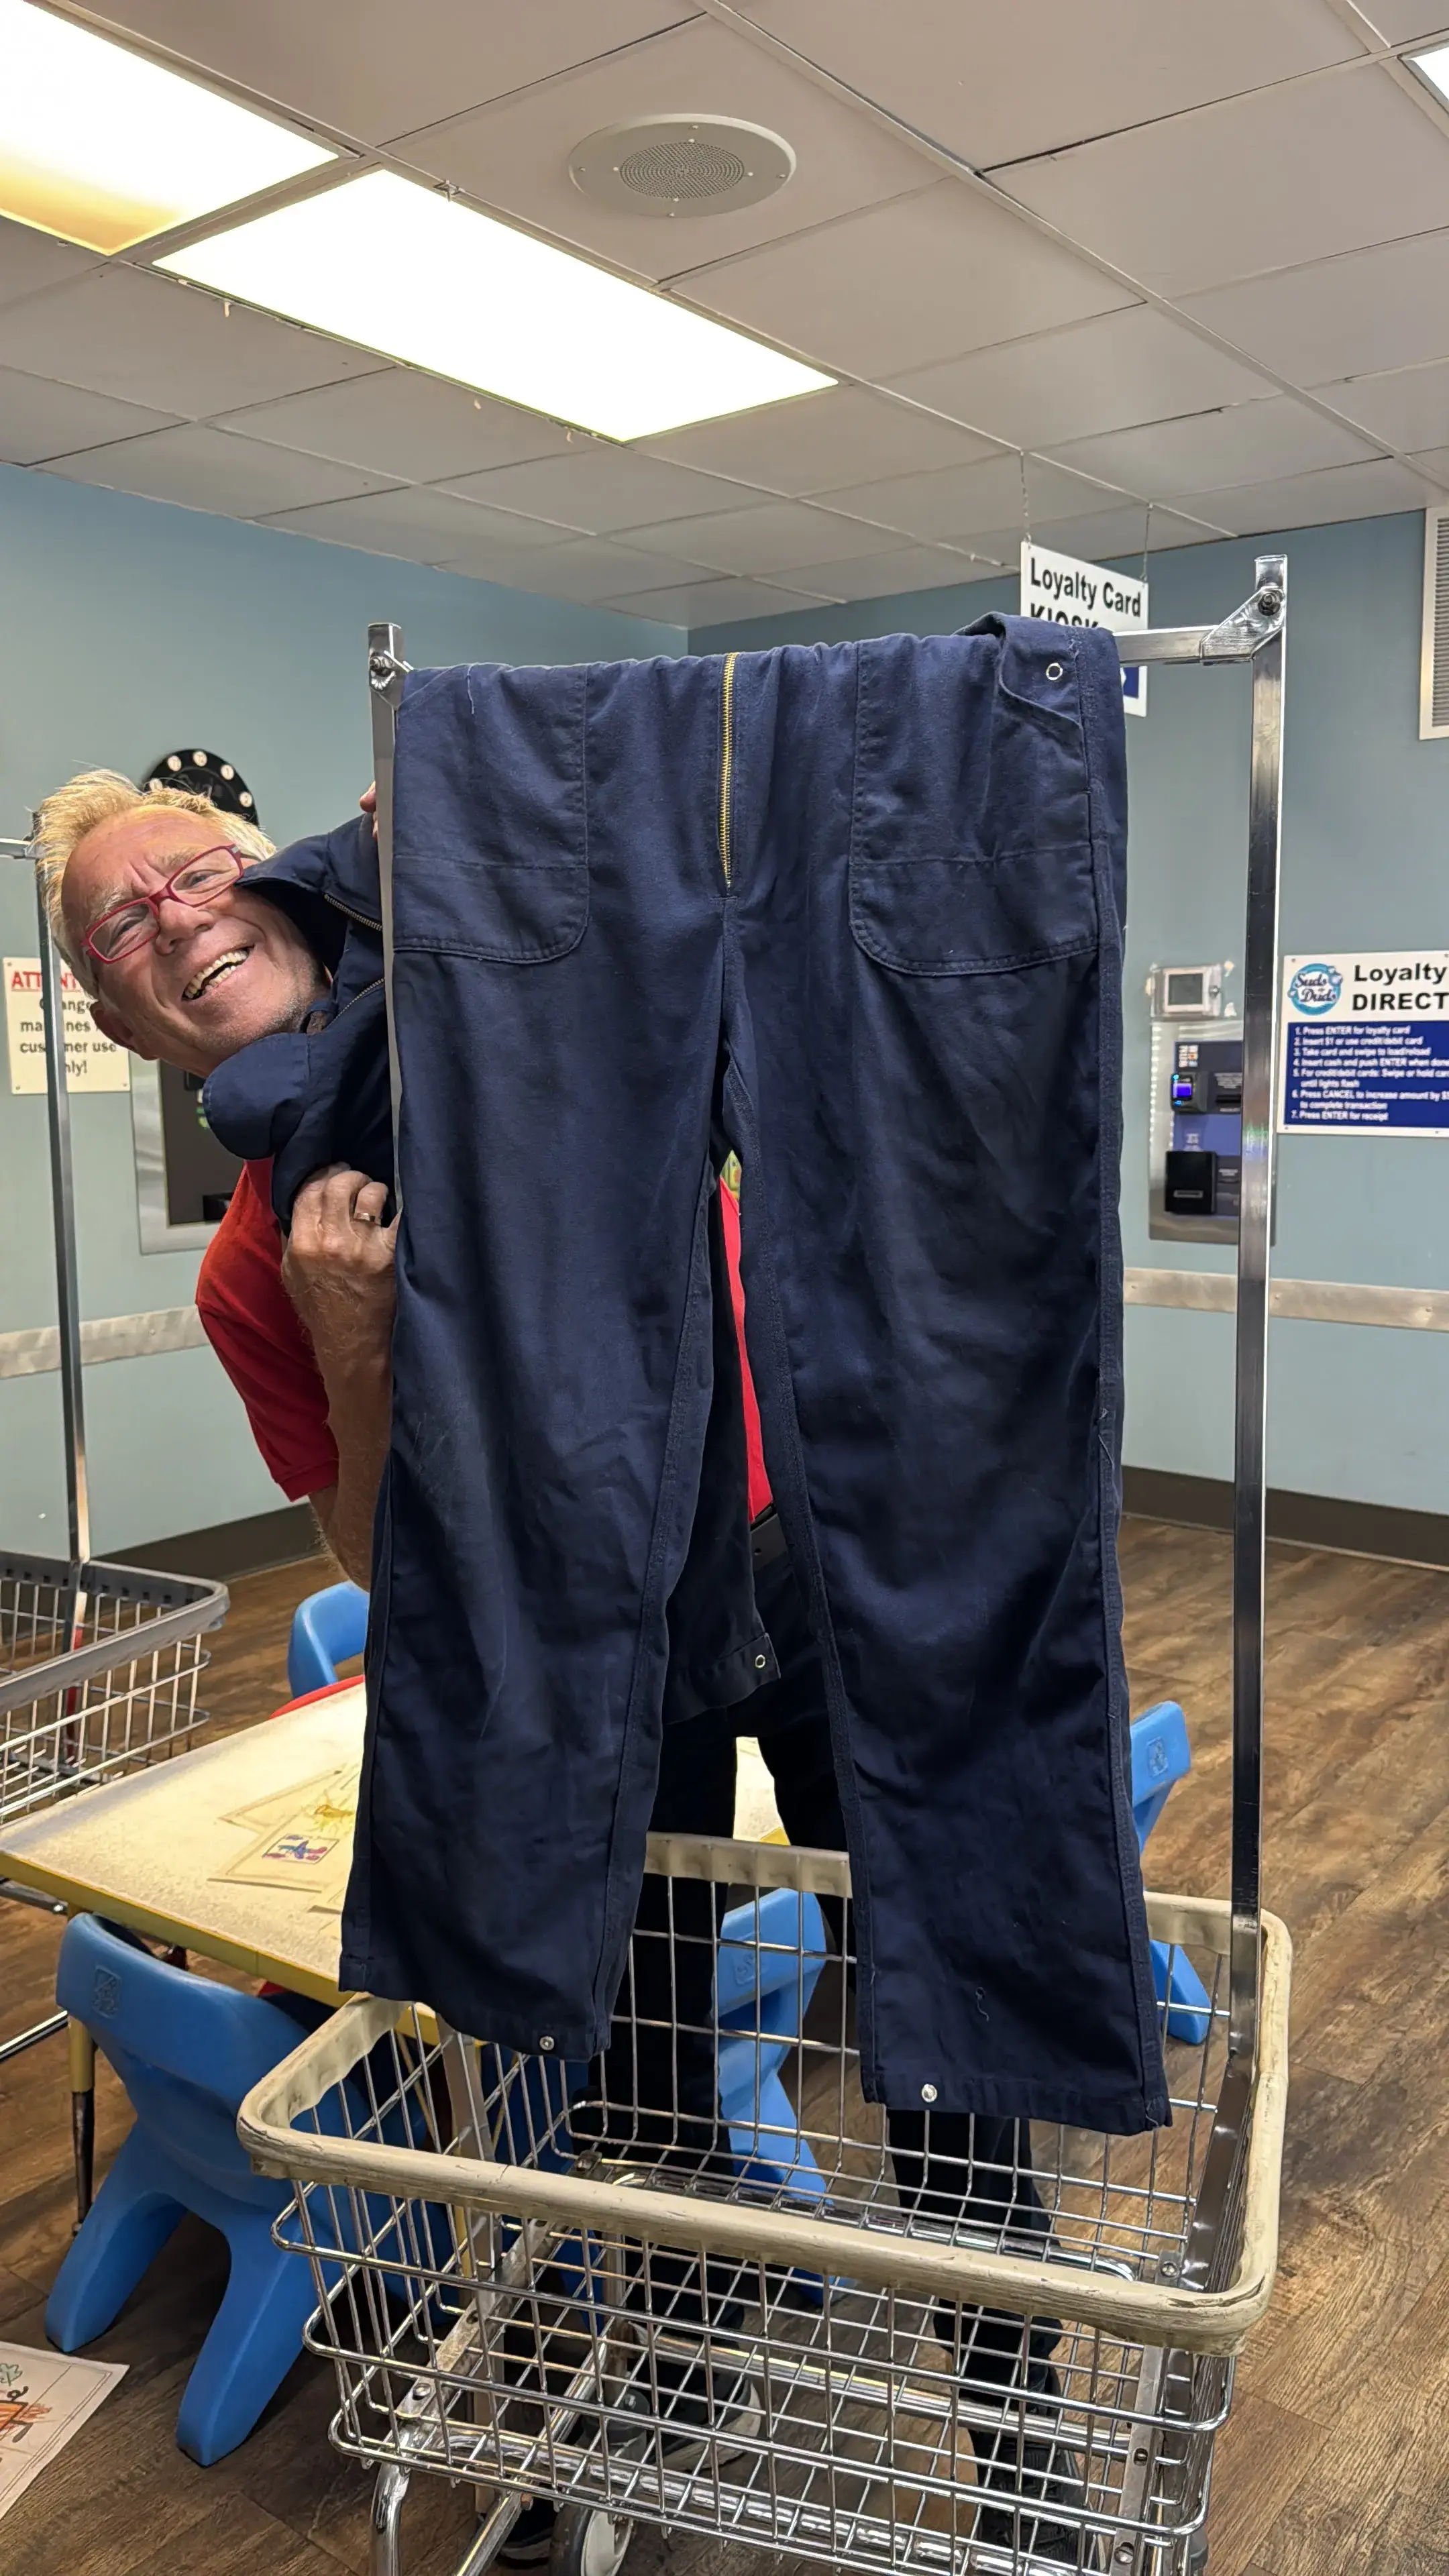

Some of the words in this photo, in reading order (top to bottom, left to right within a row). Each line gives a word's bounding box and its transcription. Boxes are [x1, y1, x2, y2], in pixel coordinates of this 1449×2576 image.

[1031, 557, 1097, 610] Loyalty
[1103, 582, 1141, 618] Card
[1295, 973, 1327, 988] Suds
[1354, 962, 1447, 985] Loyalty
[1352, 991, 1449, 1010] DIRECT
[20, 1021, 91, 1032] manes
[20, 1042, 88, 1053] cusmer
[92, 1042, 117, 1053] use
[64, 1060, 87, 1077] nly!
